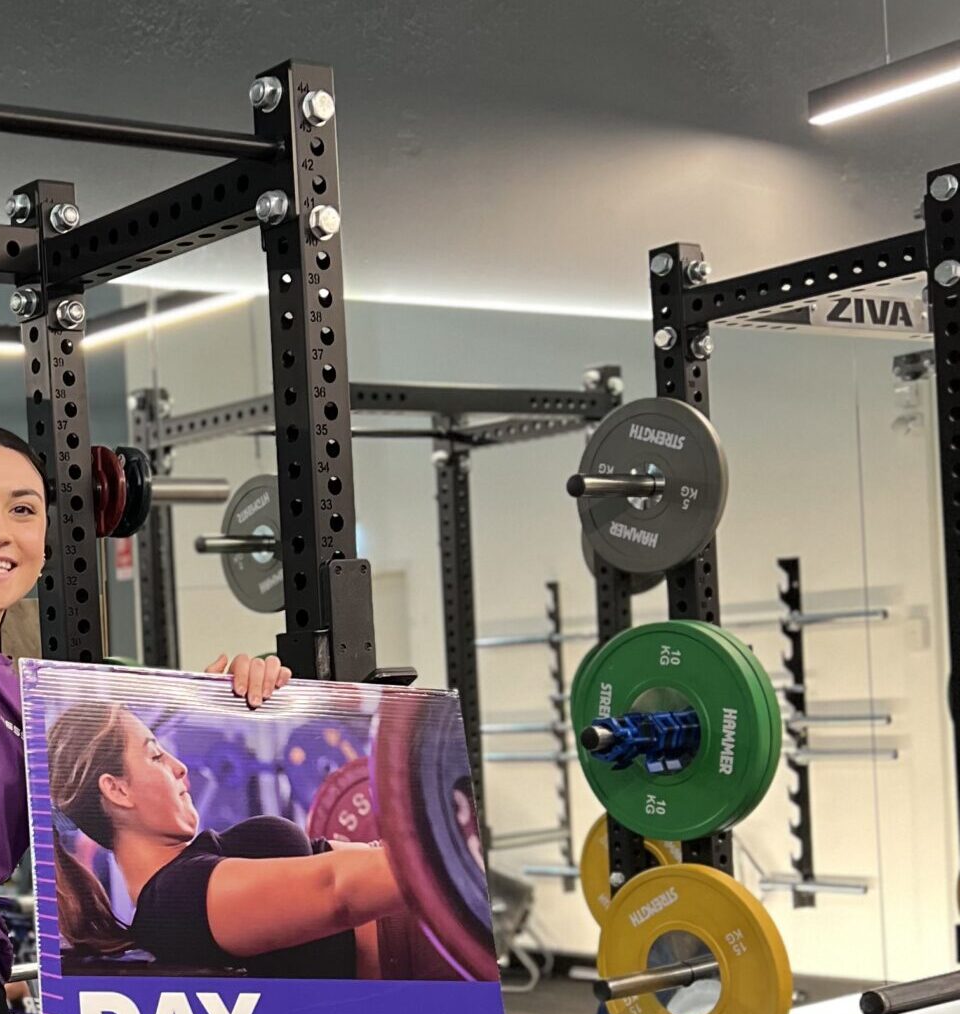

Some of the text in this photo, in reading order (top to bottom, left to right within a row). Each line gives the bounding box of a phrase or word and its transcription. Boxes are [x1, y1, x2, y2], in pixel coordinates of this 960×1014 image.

[302, 158, 315, 171] 42
[308, 273, 320, 285] 39
[310, 311, 322, 323] 38
[827, 298, 913, 327] ZIVA
[312, 348, 324, 360] 37
[55, 389, 66, 400] 38
[314, 386, 326, 398] 36
[57, 420, 68, 431] 37
[315, 423, 328, 435] 35
[629, 423, 685, 450] STRENGTH
[317, 461, 330, 473] 34
[598, 463, 614, 474] KG
[61, 483, 73, 493] 35
[680, 486, 698, 499] KG
[320, 499, 333, 510] 33
[63, 514, 74, 525] 34
[610, 521, 658, 548] HAMMER
[321, 536, 334, 548] 32
[65, 545, 77, 556] 33
[67, 576, 78, 587] 32
[659, 645, 670, 666] KG
[670, 648, 681, 666] 10
[719, 707, 737, 775] HAMMER
[645, 793, 656, 815] KG
[656, 799, 667, 815] 10
[628, 887, 678, 927] STRENGTH
[725, 928, 744, 942] KG
